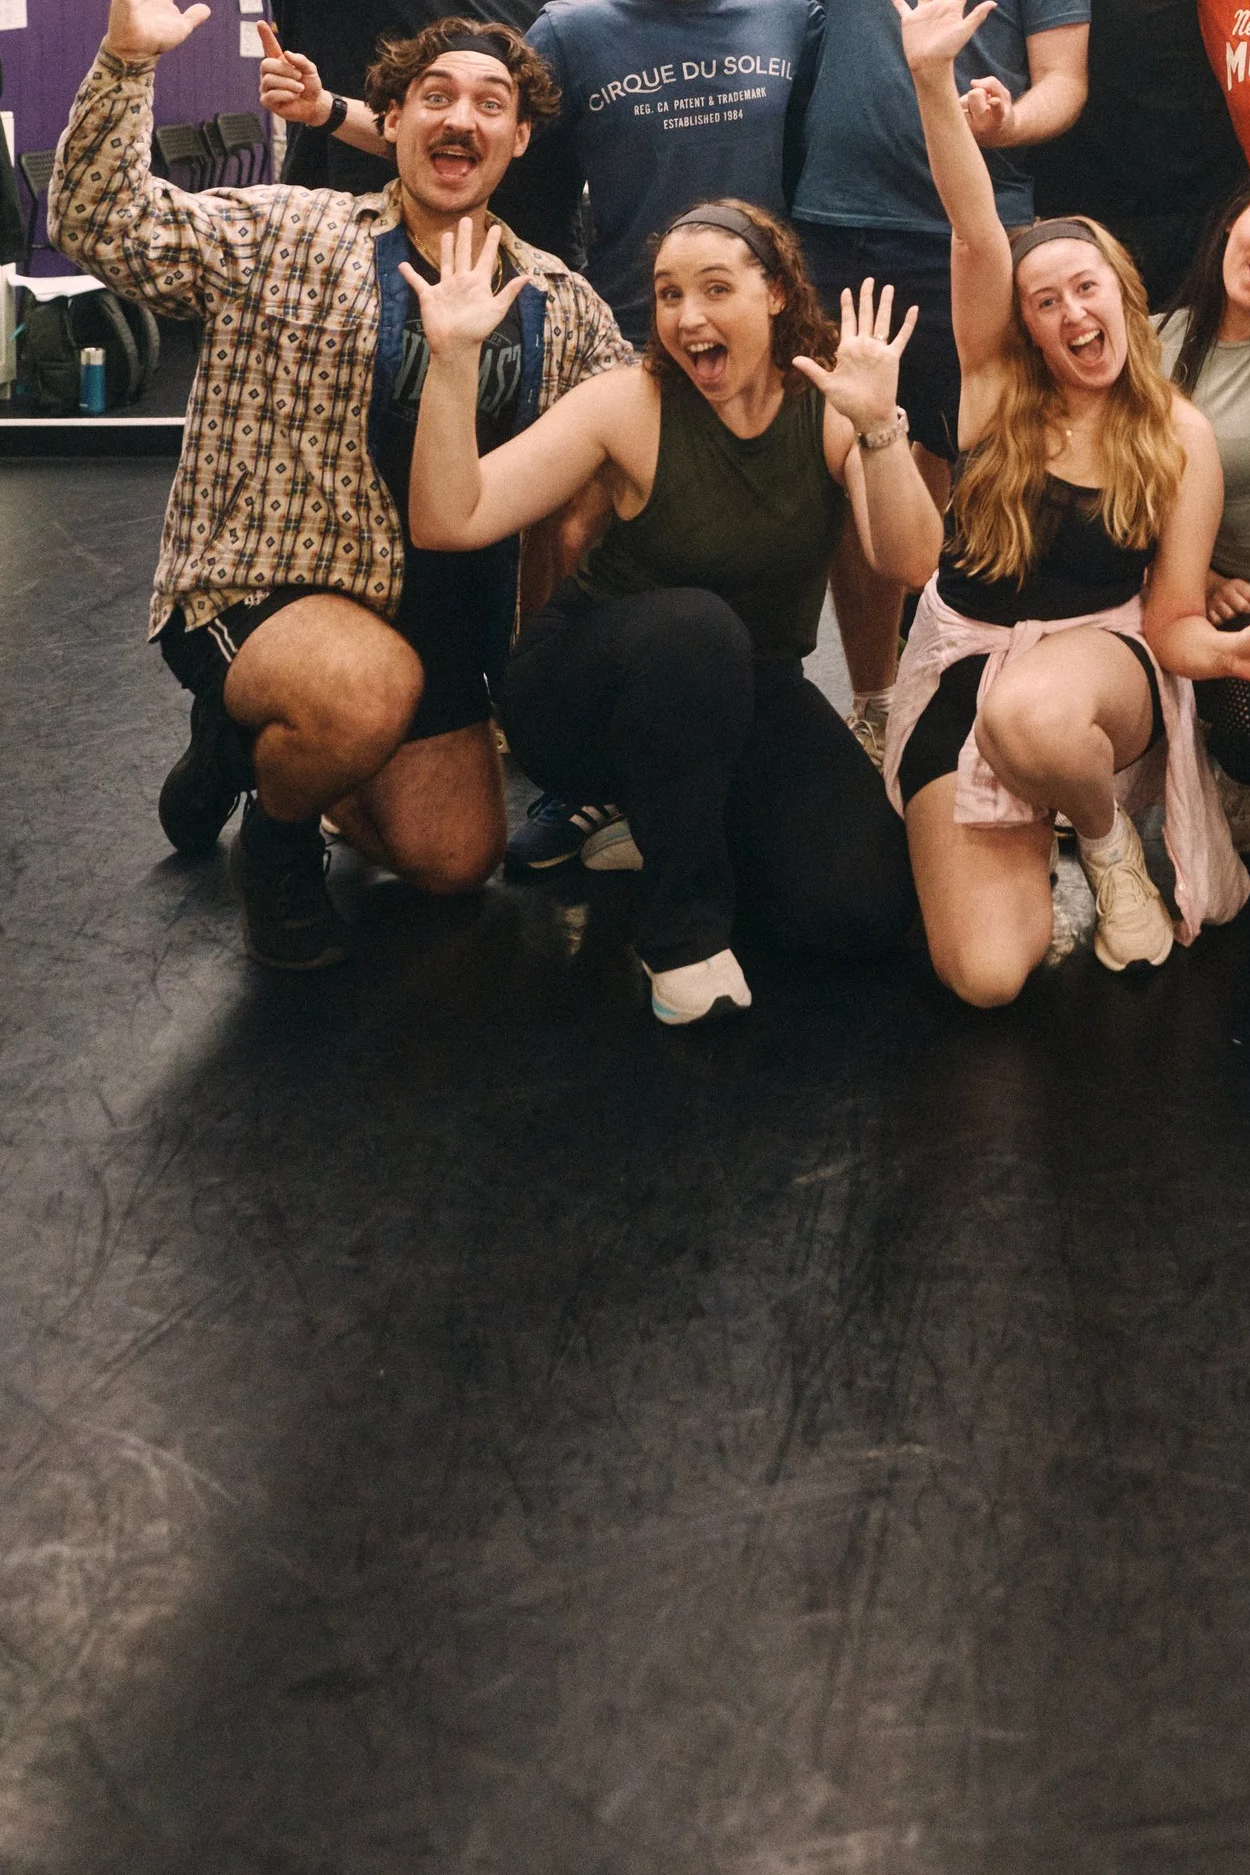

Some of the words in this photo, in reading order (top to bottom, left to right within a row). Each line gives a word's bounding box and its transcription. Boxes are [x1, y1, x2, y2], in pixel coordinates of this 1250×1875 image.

[588, 64, 676, 111] CIRQUE
[682, 60, 717, 79] DU
[723, 55, 793, 80] SOLEIL
[634, 103, 654, 116] REG.
[657, 102, 669, 113] CA
[674, 97, 705, 110] PATENT
[708, 95, 715, 107] &
[717, 87, 767, 105] TRADEMARK
[663, 112, 720, 130] ESTABLISHED
[723, 109, 744, 122] 1984
